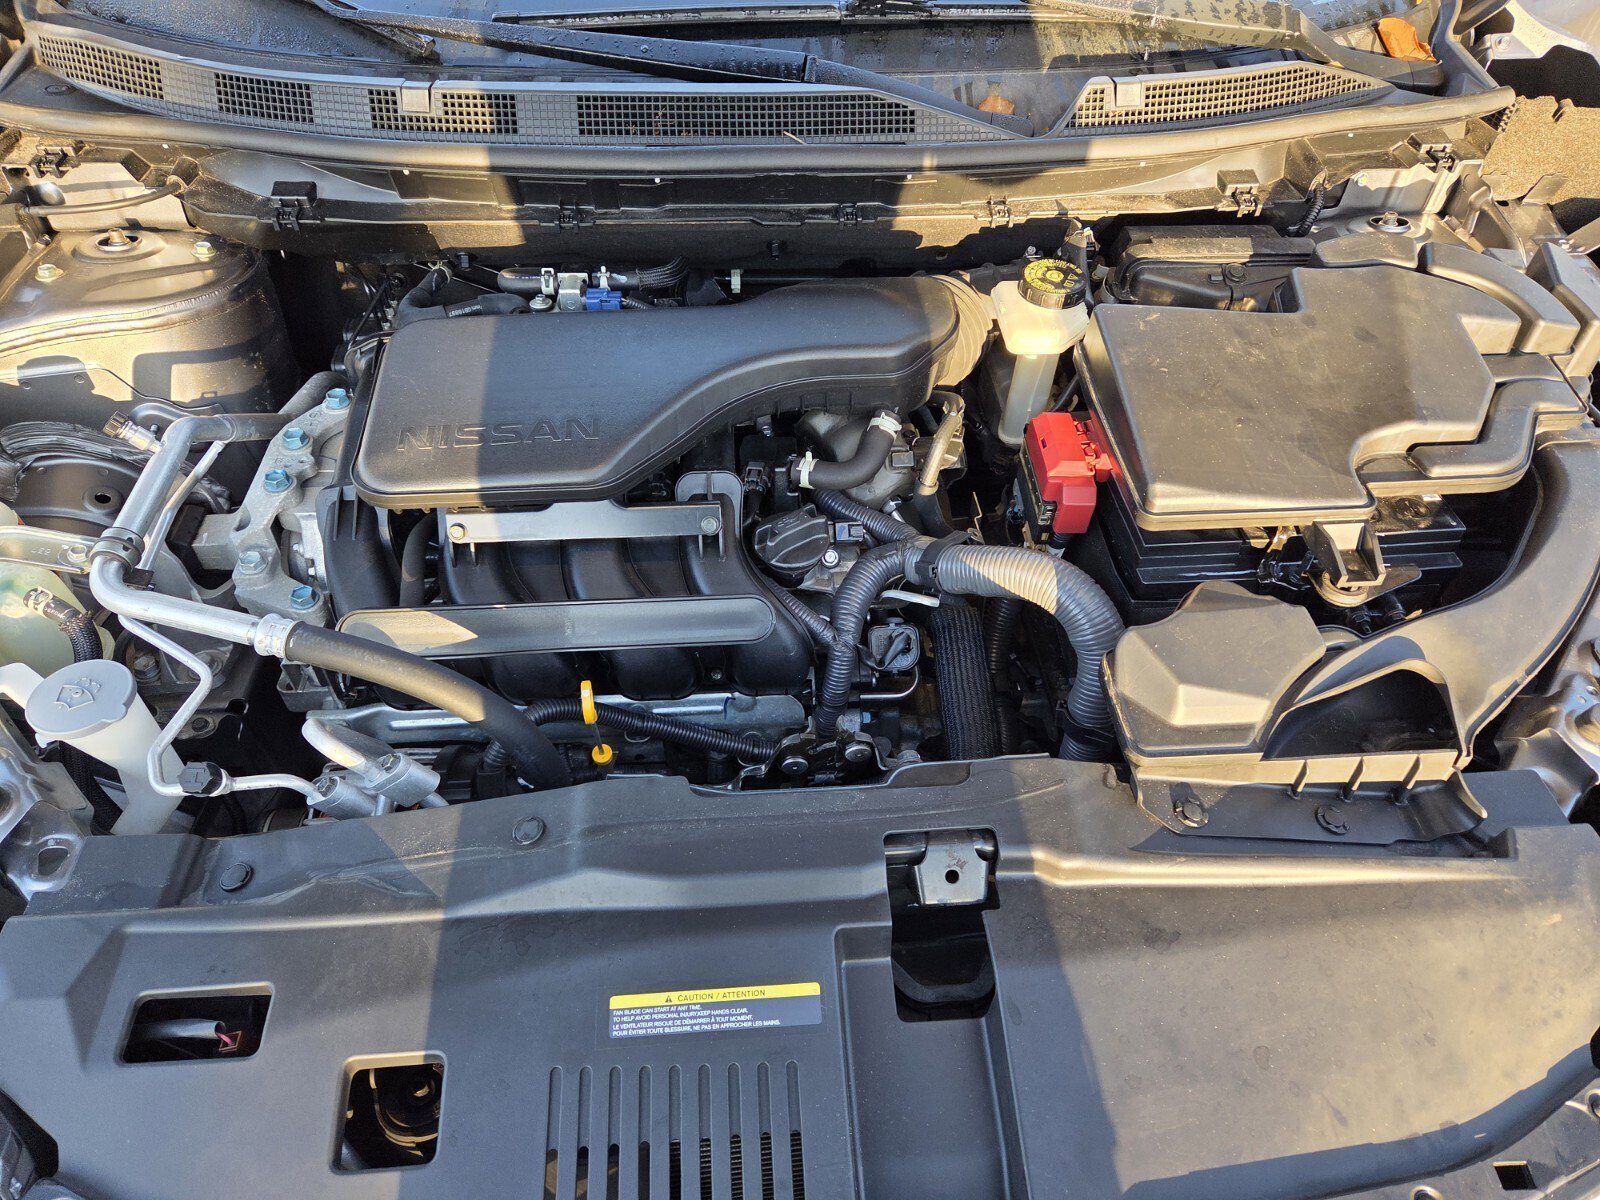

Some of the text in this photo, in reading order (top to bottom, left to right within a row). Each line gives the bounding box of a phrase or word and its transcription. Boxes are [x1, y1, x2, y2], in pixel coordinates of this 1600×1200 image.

[396, 417, 599, 450] NISSAN
[678, 993, 714, 1002] CAUTION
[722, 990, 765, 998] ATTENTION
